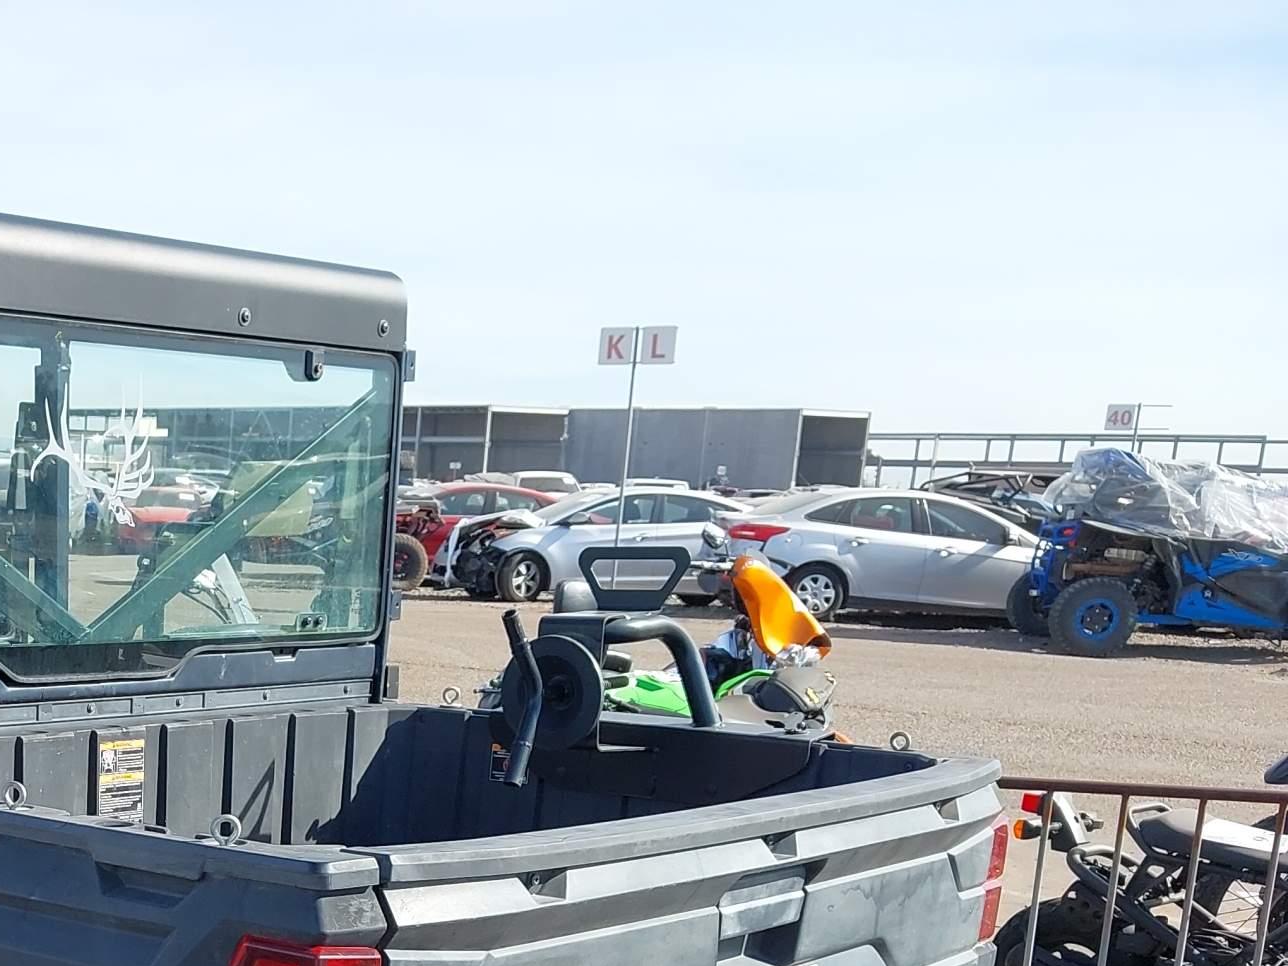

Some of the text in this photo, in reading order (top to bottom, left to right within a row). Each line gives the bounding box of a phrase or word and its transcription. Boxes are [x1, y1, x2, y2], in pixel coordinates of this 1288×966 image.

[607, 333, 625, 360] K
[650, 333, 666, 359] L
[1107, 410, 1133, 426] 40
